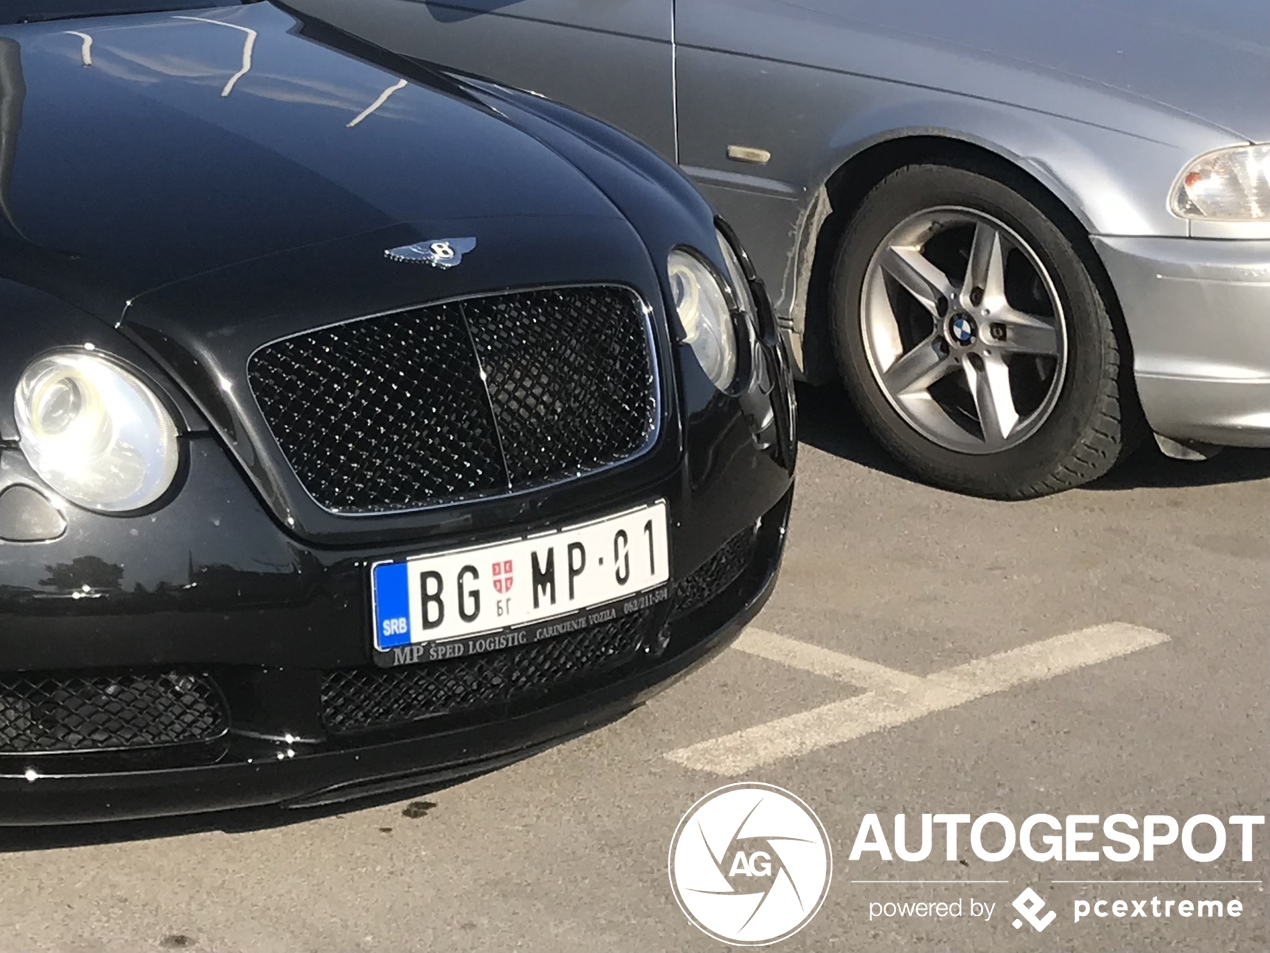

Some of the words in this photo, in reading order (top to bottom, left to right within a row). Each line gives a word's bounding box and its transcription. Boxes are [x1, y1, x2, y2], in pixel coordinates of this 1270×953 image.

[382, 617, 408, 636] SRB
[419, 565, 481, 631] BG
[393, 644, 424, 666] MP
[429, 644, 465, 661] ŠPED
[468, 630, 527, 655] LOGISTIC
[589, 608, 617, 625] VOZILA
